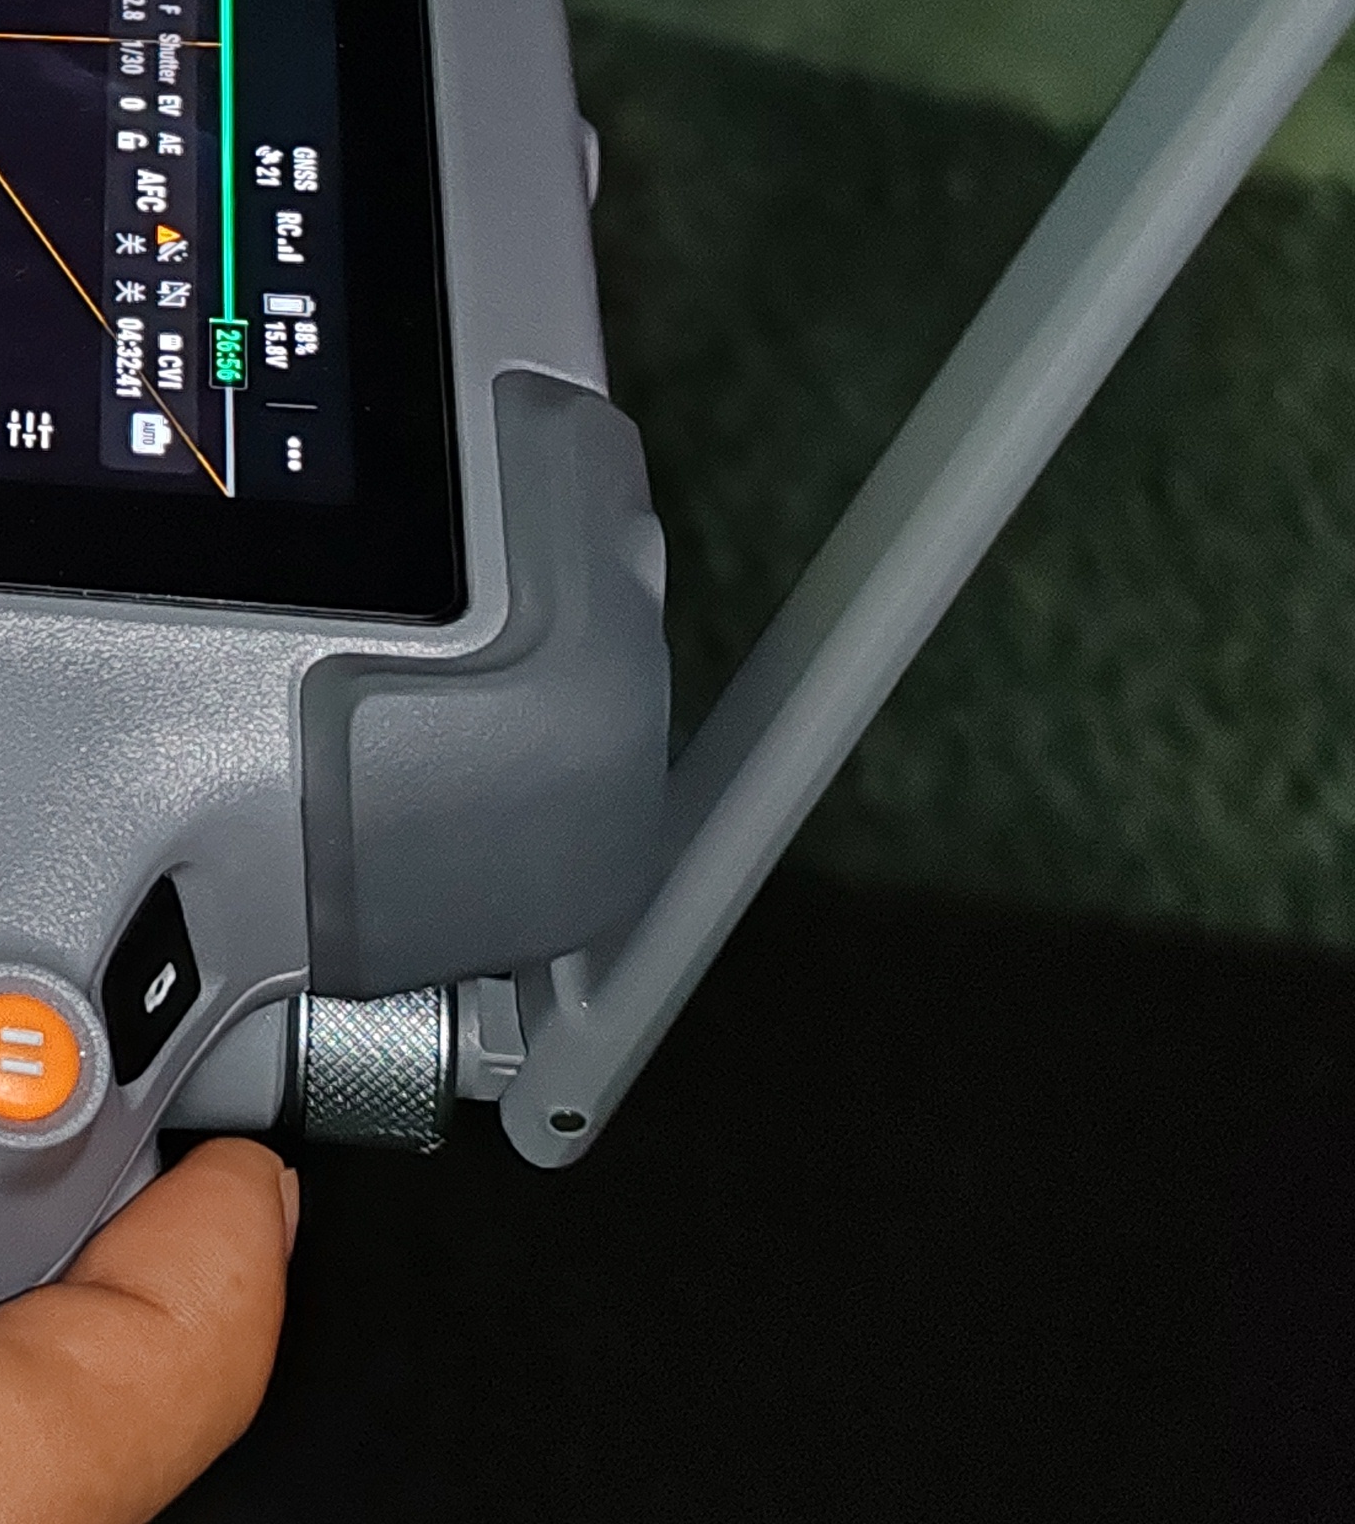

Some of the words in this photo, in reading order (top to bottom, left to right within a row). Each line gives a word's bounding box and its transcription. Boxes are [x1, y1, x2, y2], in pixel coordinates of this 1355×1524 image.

[159, 5, 182, 14] F
[121, 40, 144, 74] 1/30
[159, 33, 181, 84] Shutter
[120, 98, 147, 110] 0
[158, 95, 182, 116] EV
[157, 133, 183, 156] AE
[256, 166, 280, 186] 21
[294, 147, 317, 190] GNSS
[137, 170, 166, 212] AFC
[277, 212, 302, 237] RC
[116, 232, 146, 254] 关
[115, 280, 145, 303] 关
[265, 322, 288, 368] 15.8V
[295, 322, 317, 355] 88%
[116, 317, 143, 398] 04:32:41
[216, 329, 242, 380] 26:56
[142, 421, 155, 445] AUTO
